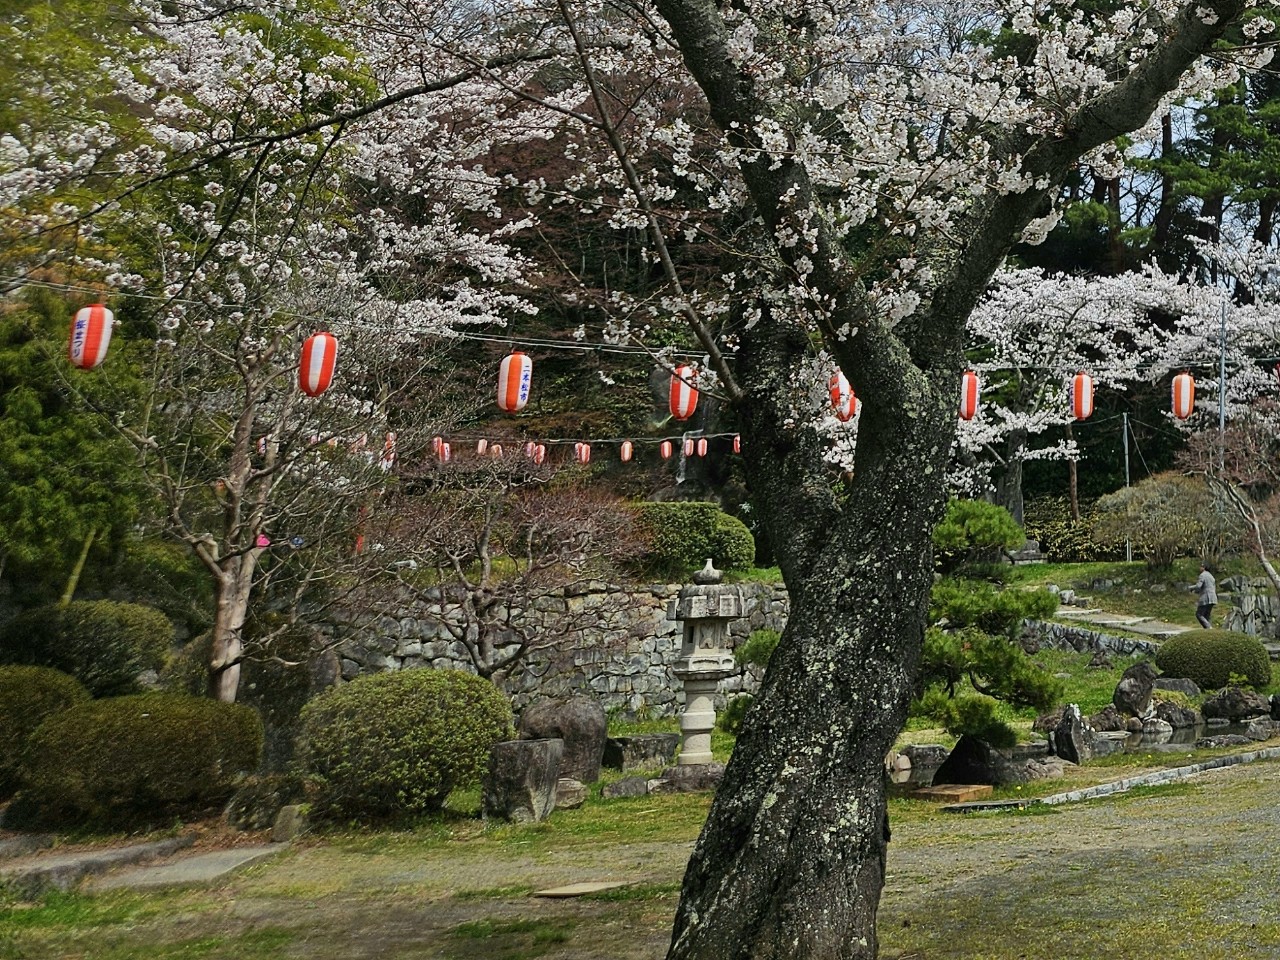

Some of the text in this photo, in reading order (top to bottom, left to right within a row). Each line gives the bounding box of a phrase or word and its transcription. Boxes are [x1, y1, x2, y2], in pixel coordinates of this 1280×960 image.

[73, 319, 87, 358] 桜まつり
[520, 365, 530, 401] 二本松市
